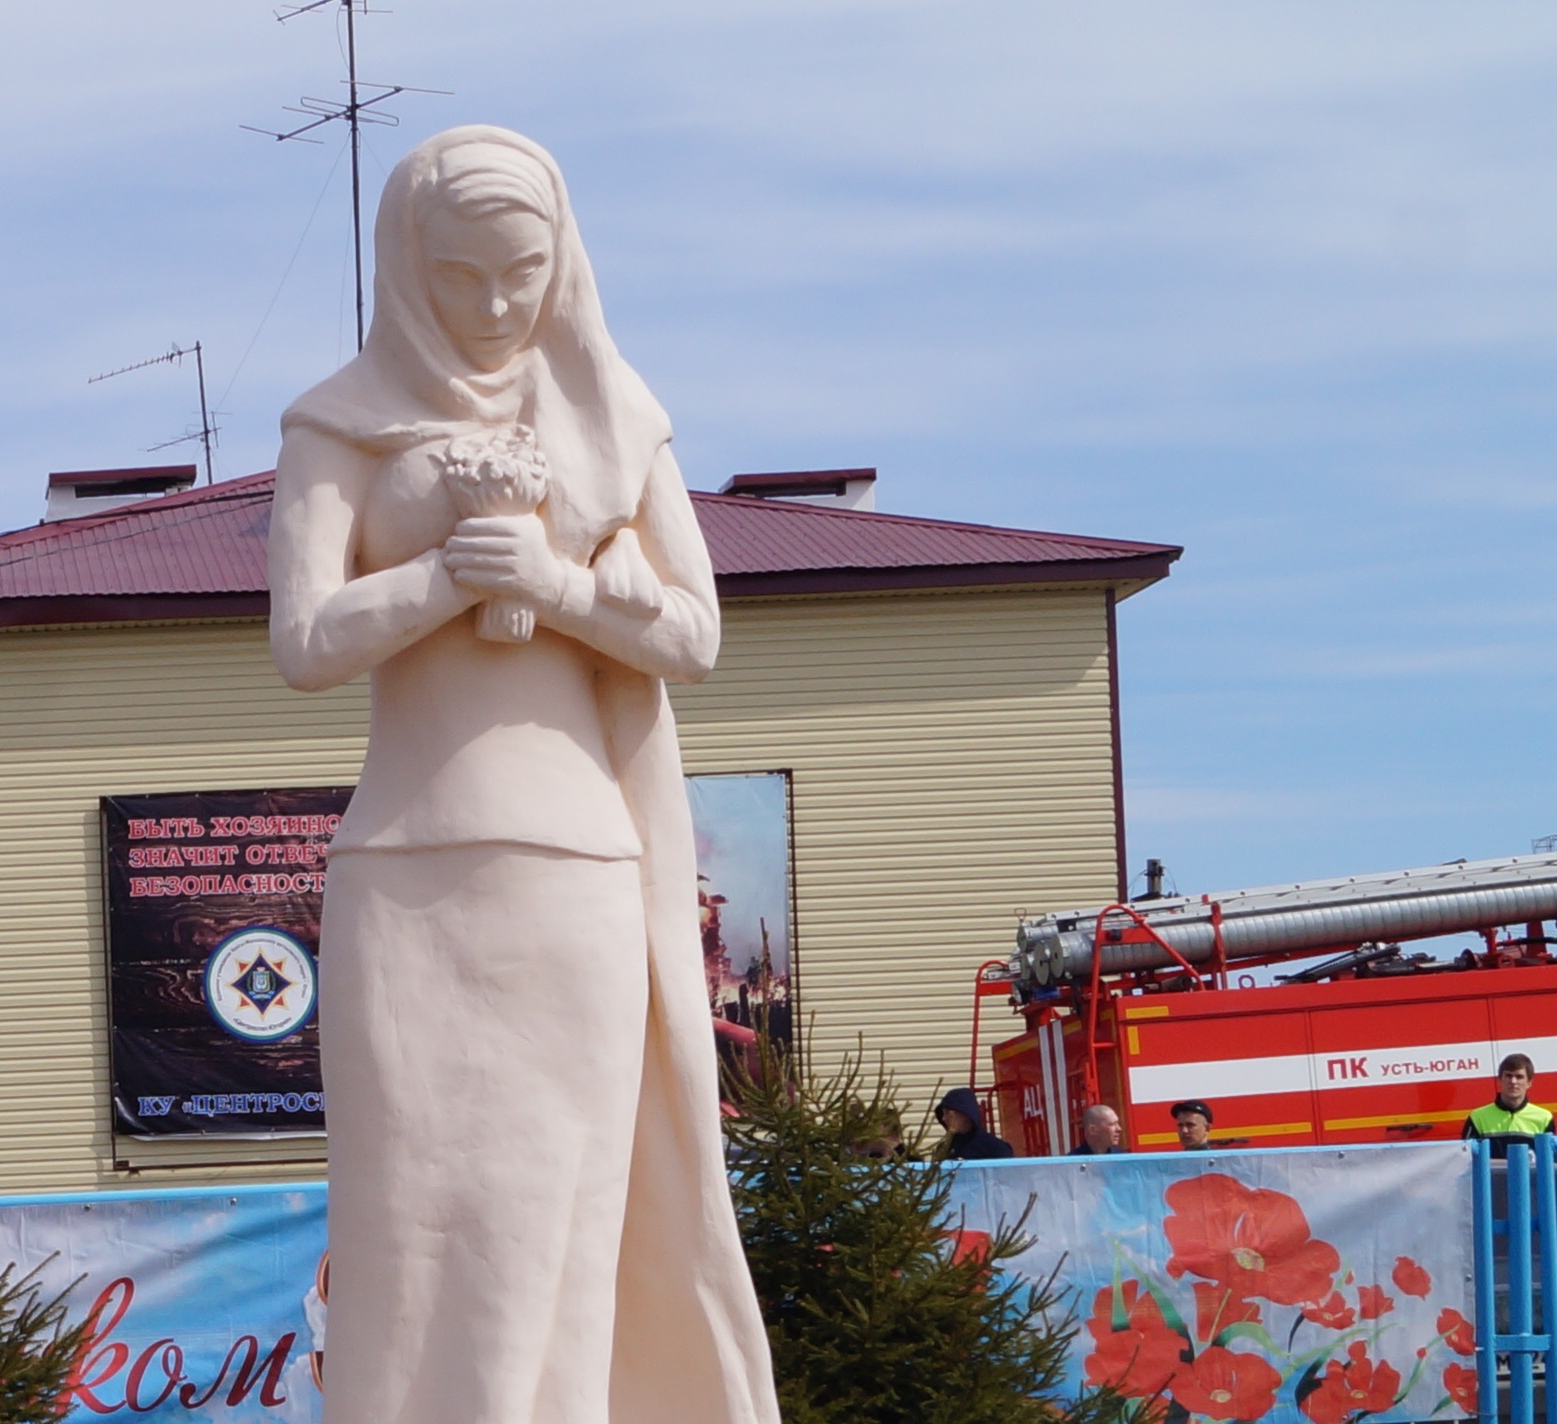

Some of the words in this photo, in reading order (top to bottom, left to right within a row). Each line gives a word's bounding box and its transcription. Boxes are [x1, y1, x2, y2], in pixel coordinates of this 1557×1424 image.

[128, 817, 205, 839] БЫТЬ
[129, 845, 239, 868] ЗНАЧИТ
[1327, 1057, 1369, 1080] ПК
[1381, 1058, 1479, 1076] УСТЬ-ЮГАН
[138, 1096, 175, 1116] КУ
